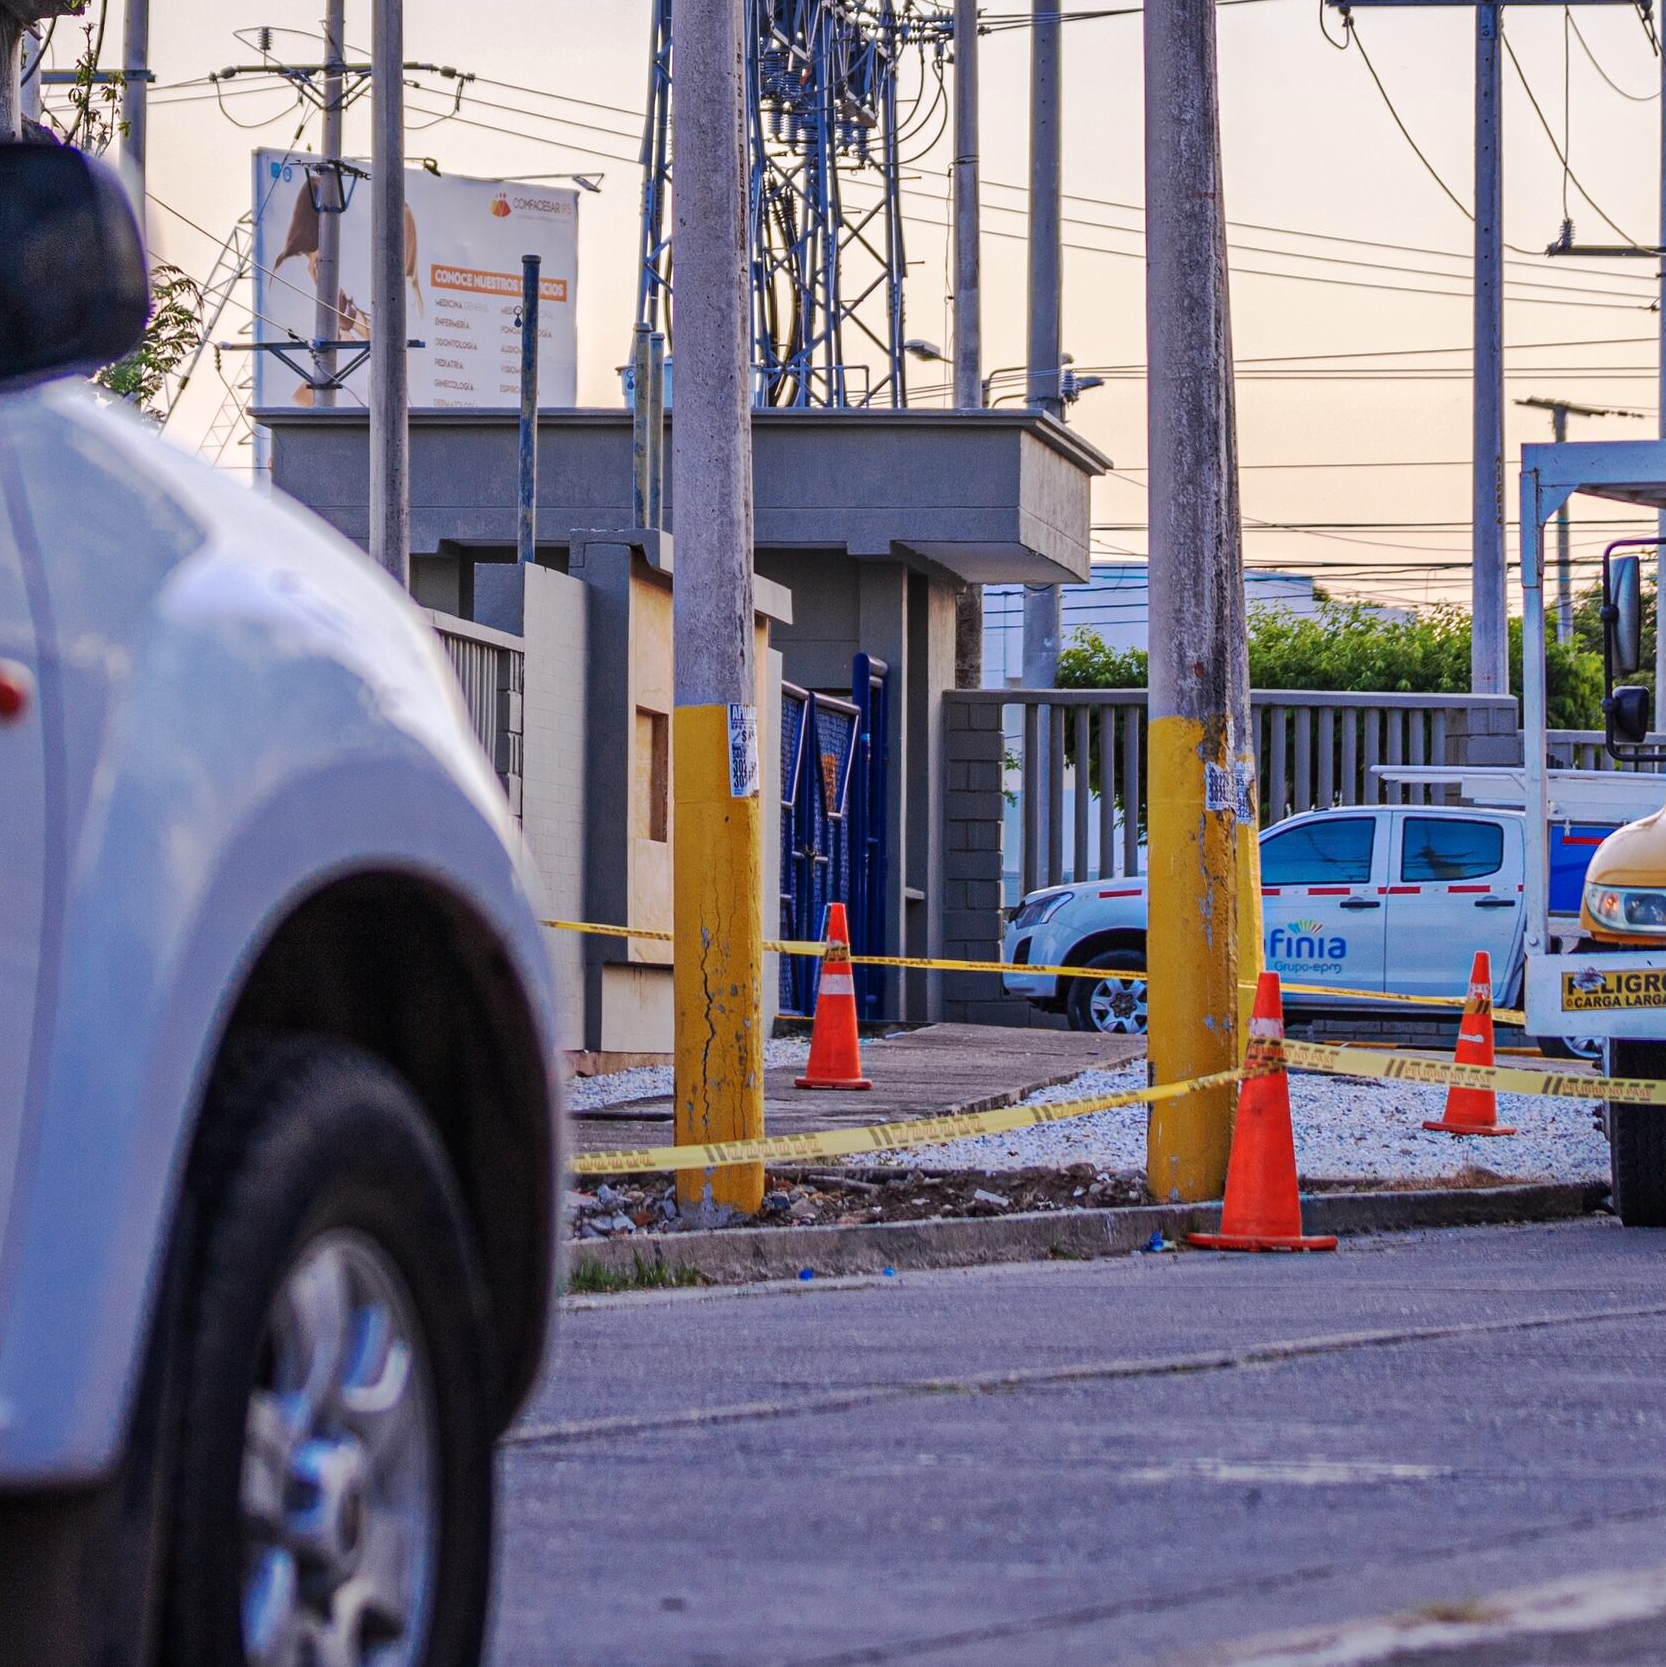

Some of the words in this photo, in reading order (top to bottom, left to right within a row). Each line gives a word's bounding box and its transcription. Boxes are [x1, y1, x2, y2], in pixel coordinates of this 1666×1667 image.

[434, 269, 473, 286] CONOCE
[474, 275, 519, 292] NUESTROS
[1264, 928, 1346, 959] finia
[1574, 995, 1622, 1008] CARGA
[1294, 1049, 1308, 1060] NO
[1449, 1071, 1464, 1081] NO
[1609, 1085, 1623, 1096] NO
